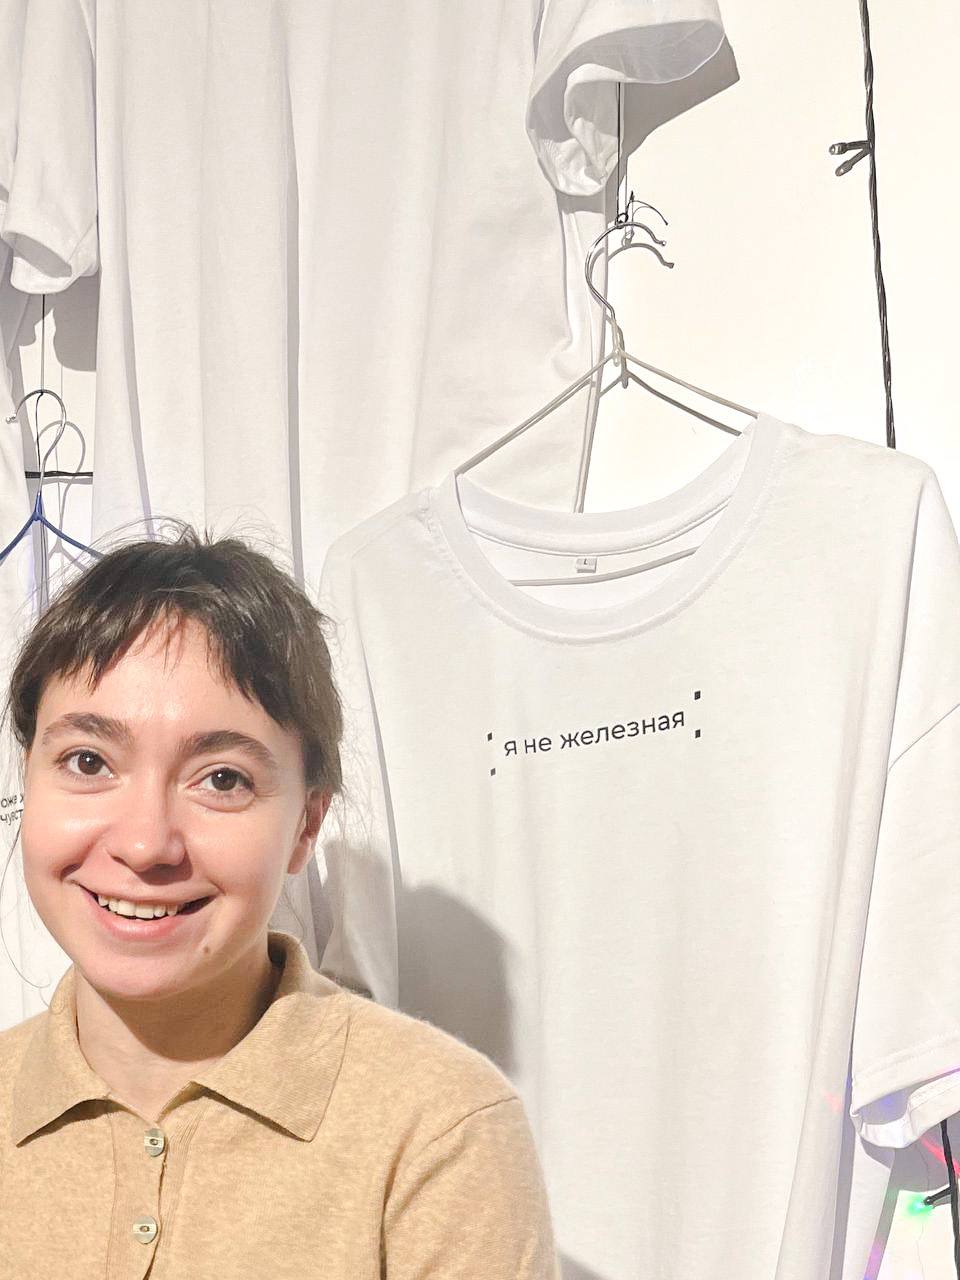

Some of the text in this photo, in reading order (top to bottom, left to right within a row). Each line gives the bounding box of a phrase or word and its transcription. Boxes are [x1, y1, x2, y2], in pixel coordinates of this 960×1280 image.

[503, 710, 686, 757] я не железная
